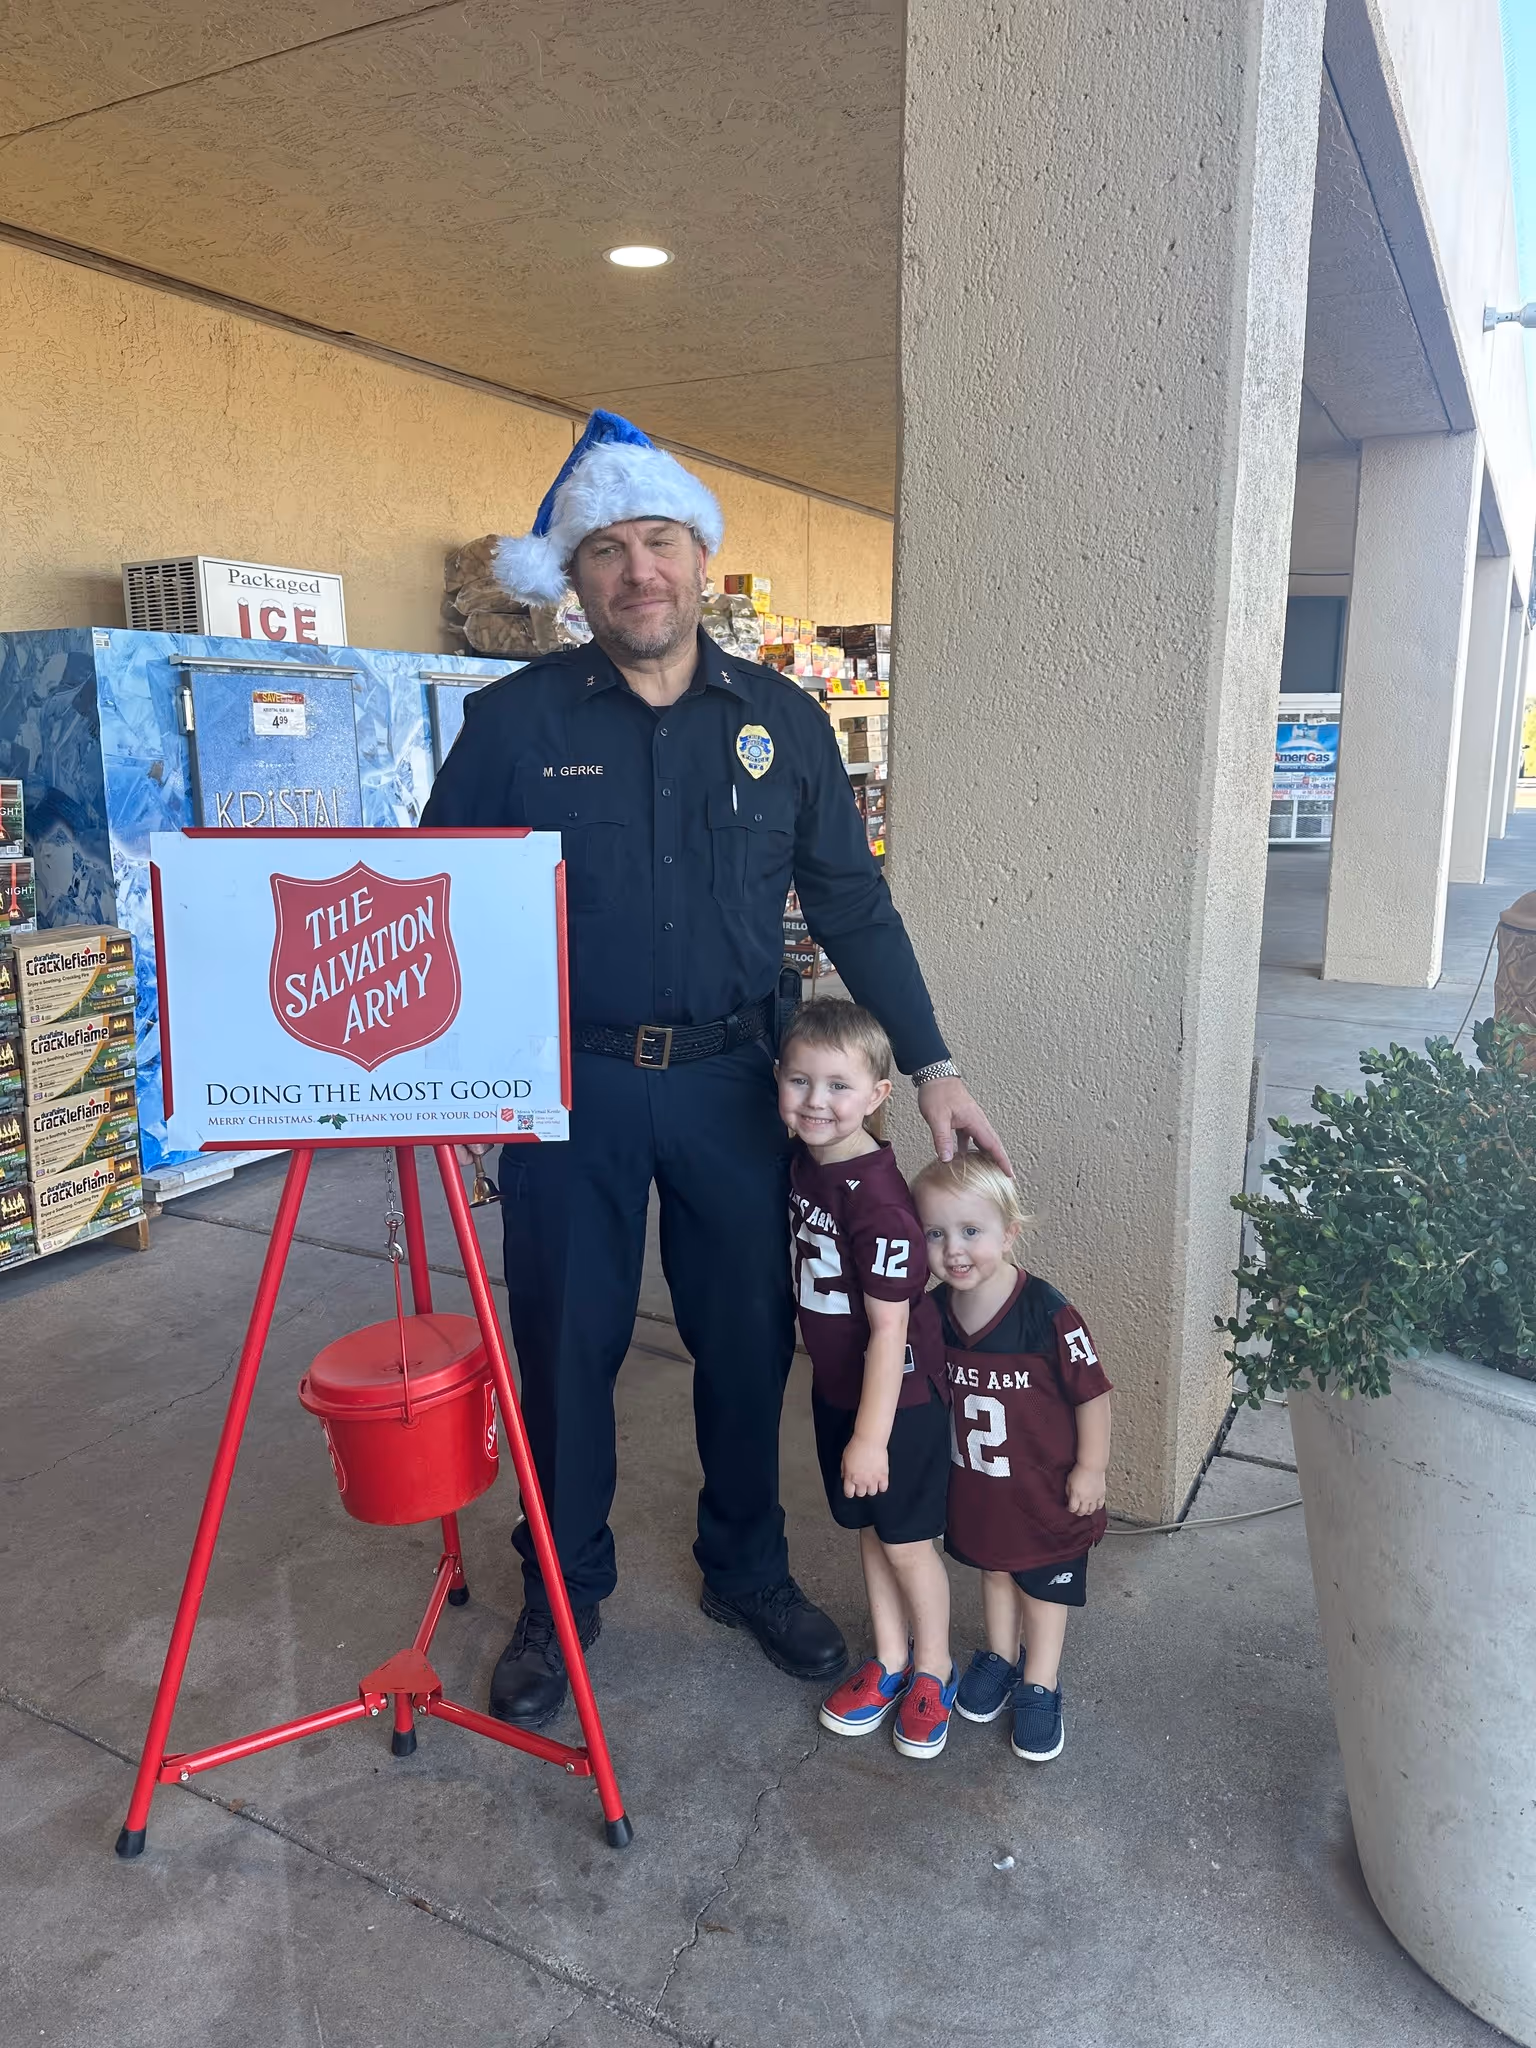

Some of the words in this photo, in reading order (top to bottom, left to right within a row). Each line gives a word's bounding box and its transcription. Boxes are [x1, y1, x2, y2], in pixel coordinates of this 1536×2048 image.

[228, 568, 321, 595] Packaged
[237, 597, 319, 645] ICE
[543, 766, 557, 777] M.
[560, 765, 604, 776] GERKE
[305, 886, 374, 950] THE
[26, 953, 106, 976] Crackleflame
[285, 895, 436, 1018] SALVATION
[341, 953, 433, 1044] ARMY
[31, 1028, 108, 1055] Crackleflame
[206, 1083, 302, 1105] DOING
[308, 1083, 361, 1103] THE
[369, 1081, 443, 1101] MOST
[451, 1079, 531, 1100] GOOD
[34, 1102, 110, 1132] Crackleflame
[208, 1116, 245, 1126] MERRY
[348, 1112, 388, 1122] THANK
[390, 1112, 413, 1121] YOU
[416, 1111, 438, 1120] FOR
[440, 1110, 470, 1120] YOUR
[40, 1172, 114, 1207] Crackleflame
[871, 1237, 909, 1278] 12
[987, 1371, 1030, 1390] A&M
